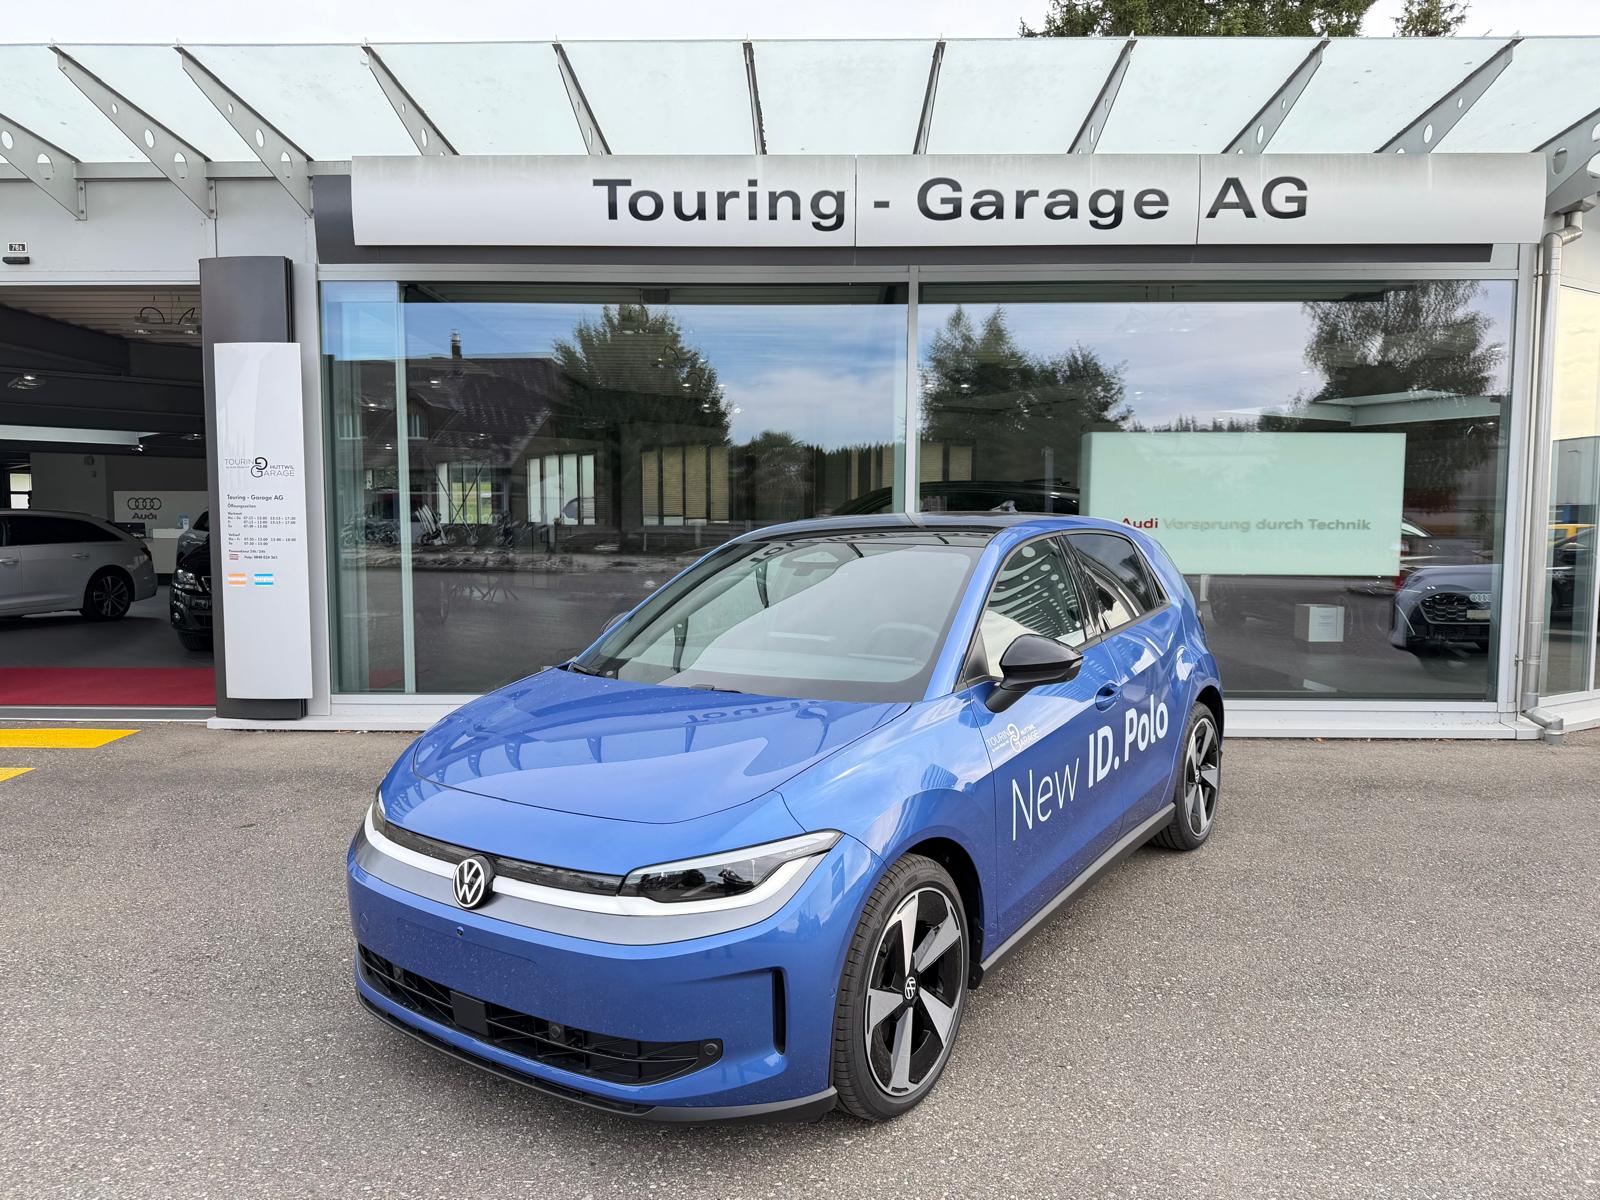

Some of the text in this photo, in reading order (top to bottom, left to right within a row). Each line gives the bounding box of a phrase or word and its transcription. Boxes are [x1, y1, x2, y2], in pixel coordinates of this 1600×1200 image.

[592, 176, 1309, 232] Touring - Garage AG
[226, 494, 246, 502] Touring
[250, 494, 273, 502] Garage
[131, 512, 157, 520] Audi
[1163, 518, 1251, 533] Vorsprung
[1256, 517, 1304, 530] durch
[1308, 518, 1372, 531] Technik
[1012, 694, 1169, 841] New ID. Polo
